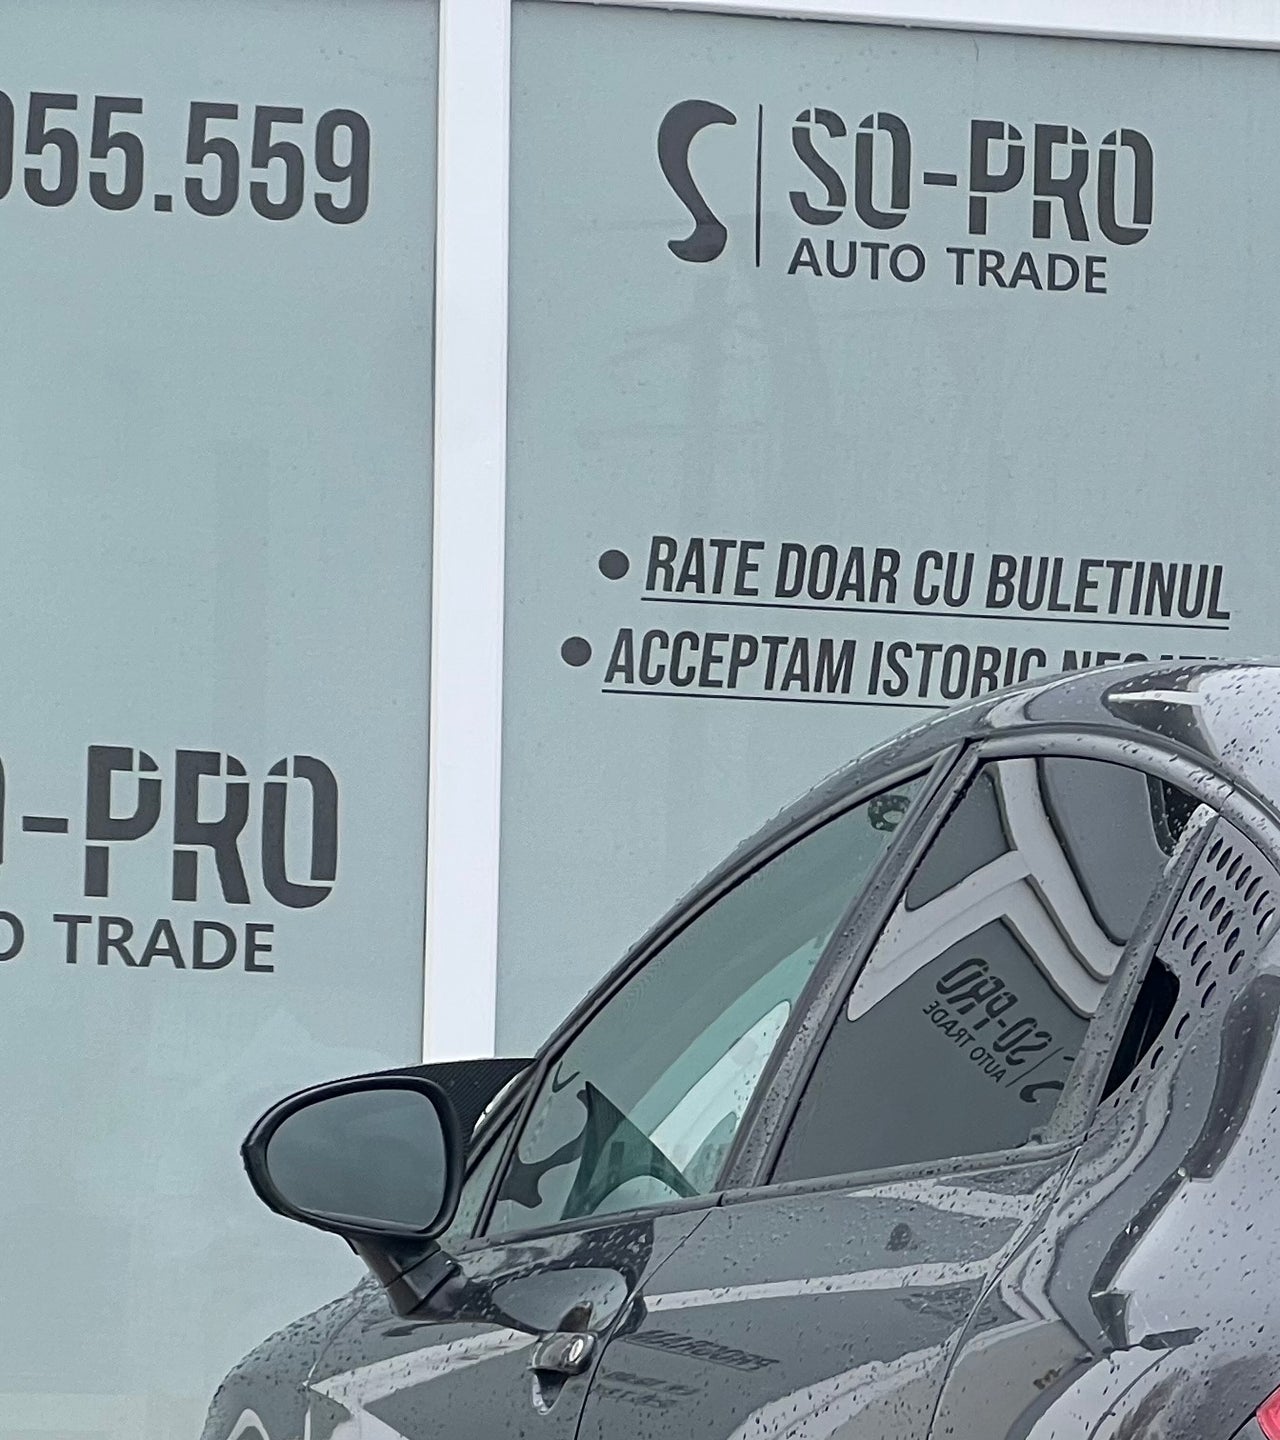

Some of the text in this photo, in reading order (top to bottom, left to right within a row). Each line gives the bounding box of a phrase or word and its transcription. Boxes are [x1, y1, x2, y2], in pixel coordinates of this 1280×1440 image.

[0, 91, 371, 225] 55.559
[789, 108, 1154, 245] SO-PRO
[788, 238, 1107, 295] AUTO TRADE
[646, 536, 1231, 621] RATE DOAR CU BULETINUL
[603, 628, 857, 695] ACCEPTAM
[0, 745, 338, 909] -PRO
[53, 913, 275, 973] TRADE
